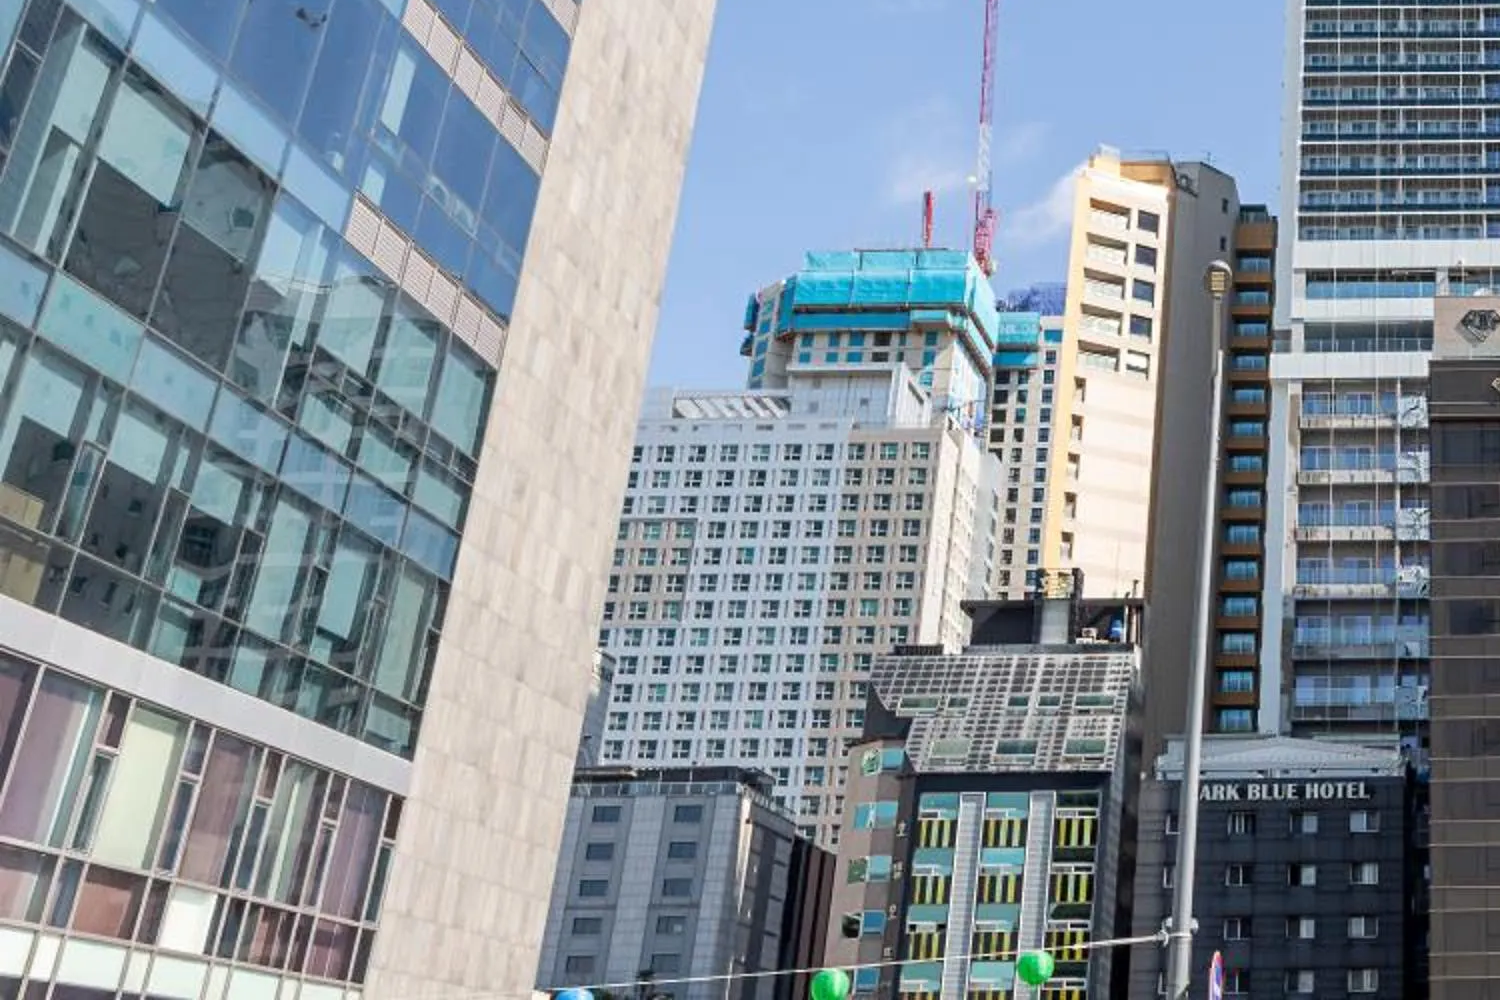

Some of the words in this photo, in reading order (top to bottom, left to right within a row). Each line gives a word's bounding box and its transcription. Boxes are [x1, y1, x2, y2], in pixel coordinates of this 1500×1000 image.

[1200, 783, 1239, 801] ARK
[1247, 783, 1298, 800] BLUE
[1305, 781, 1370, 800] HOTEL
